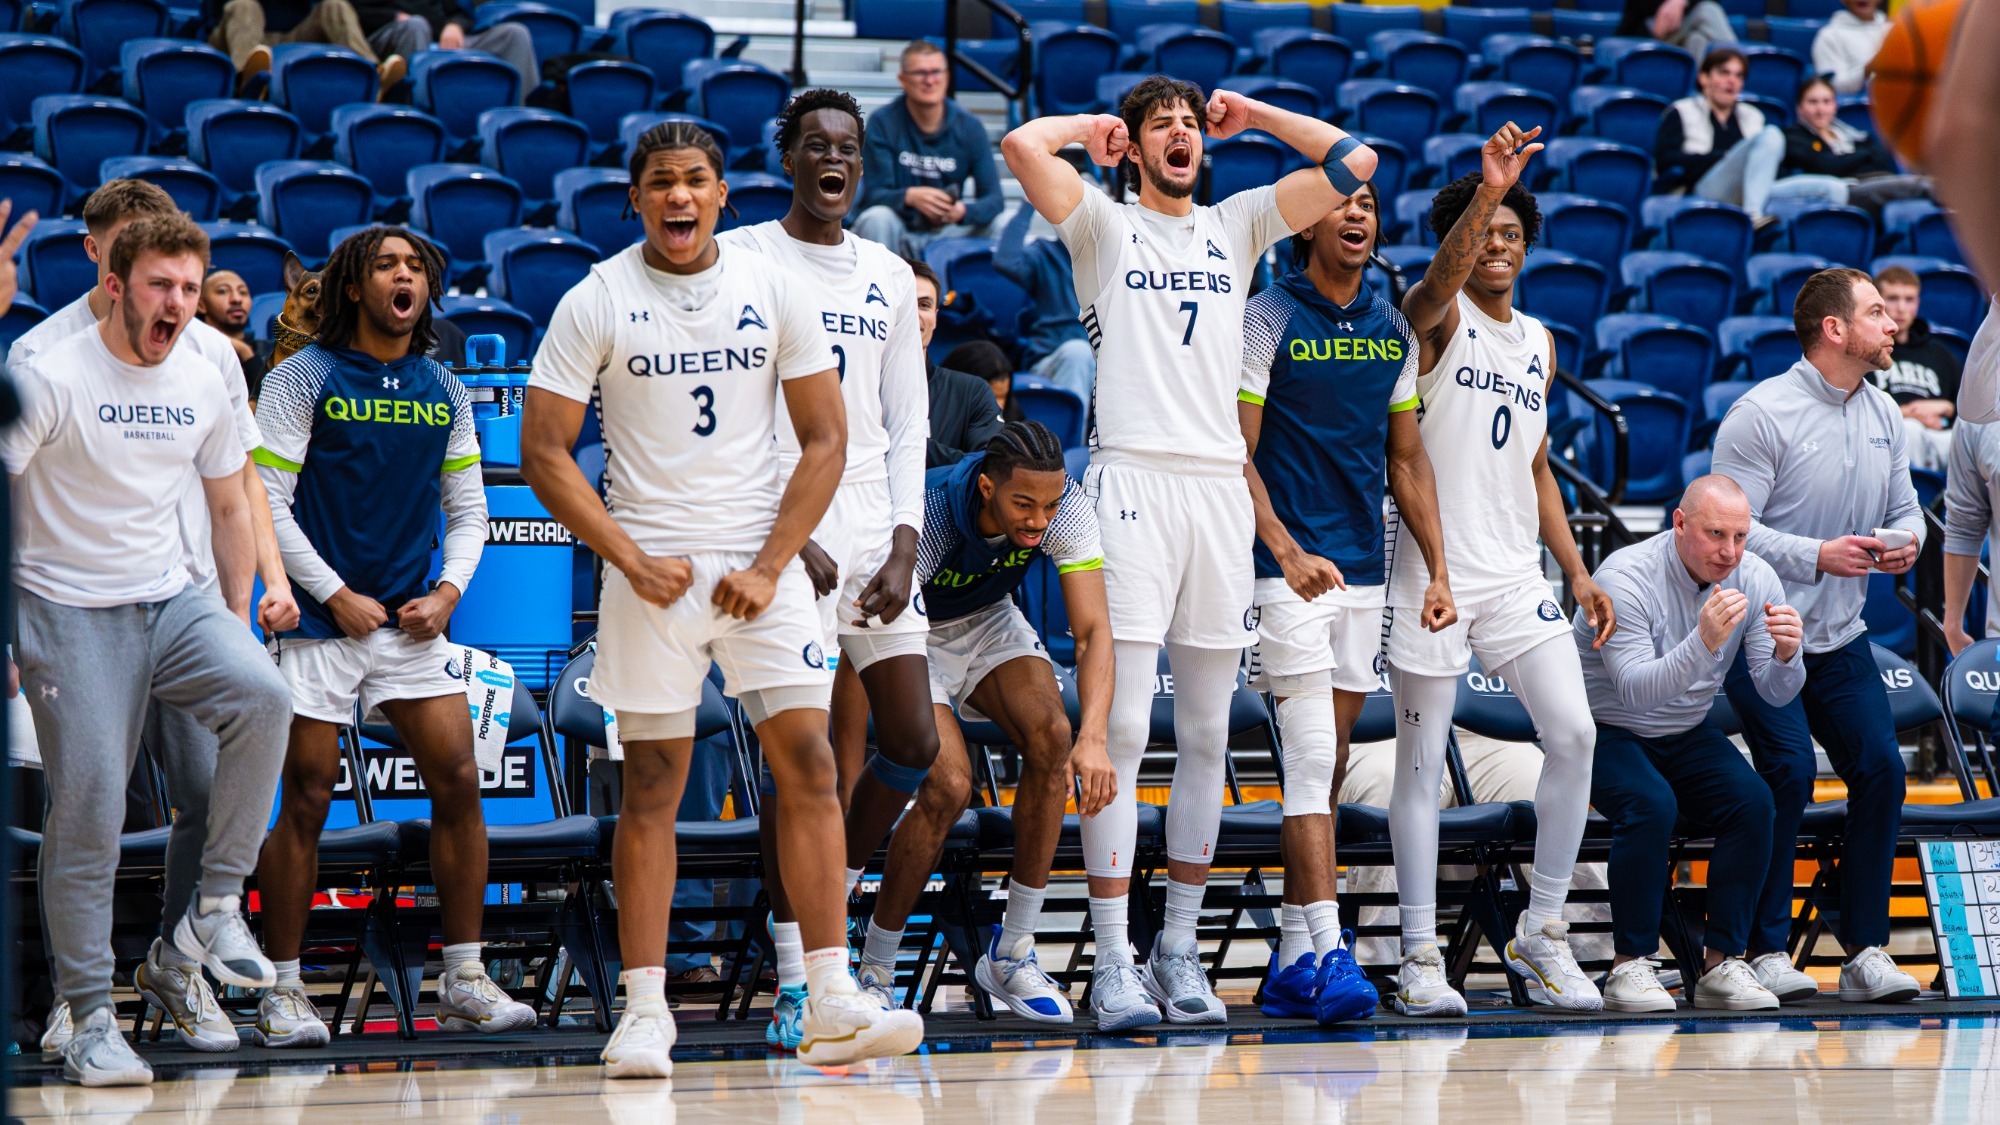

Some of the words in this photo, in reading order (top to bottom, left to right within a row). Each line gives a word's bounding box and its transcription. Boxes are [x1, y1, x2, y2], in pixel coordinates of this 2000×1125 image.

[899, 151, 957, 172] QUEENS
[1125, 270, 1231, 294] QUEENS
[821, 311, 888, 341] EENS
[1178, 300, 1199, 346] 7
[627, 346, 767, 377] QUEENS
[1290, 338, 1403, 361] QUEENS
[98, 404, 195, 426] QUEENS
[325, 396, 451, 426] QUEENS
[688, 385, 717, 437] 3
[123, 430, 175, 441] BASKETBALL
[1491, 404, 1512, 450] 0
[1869, 436, 1891, 445] QUEEN
[486, 521, 572, 543] WERADE
[479, 688, 496, 740] POWERADE
